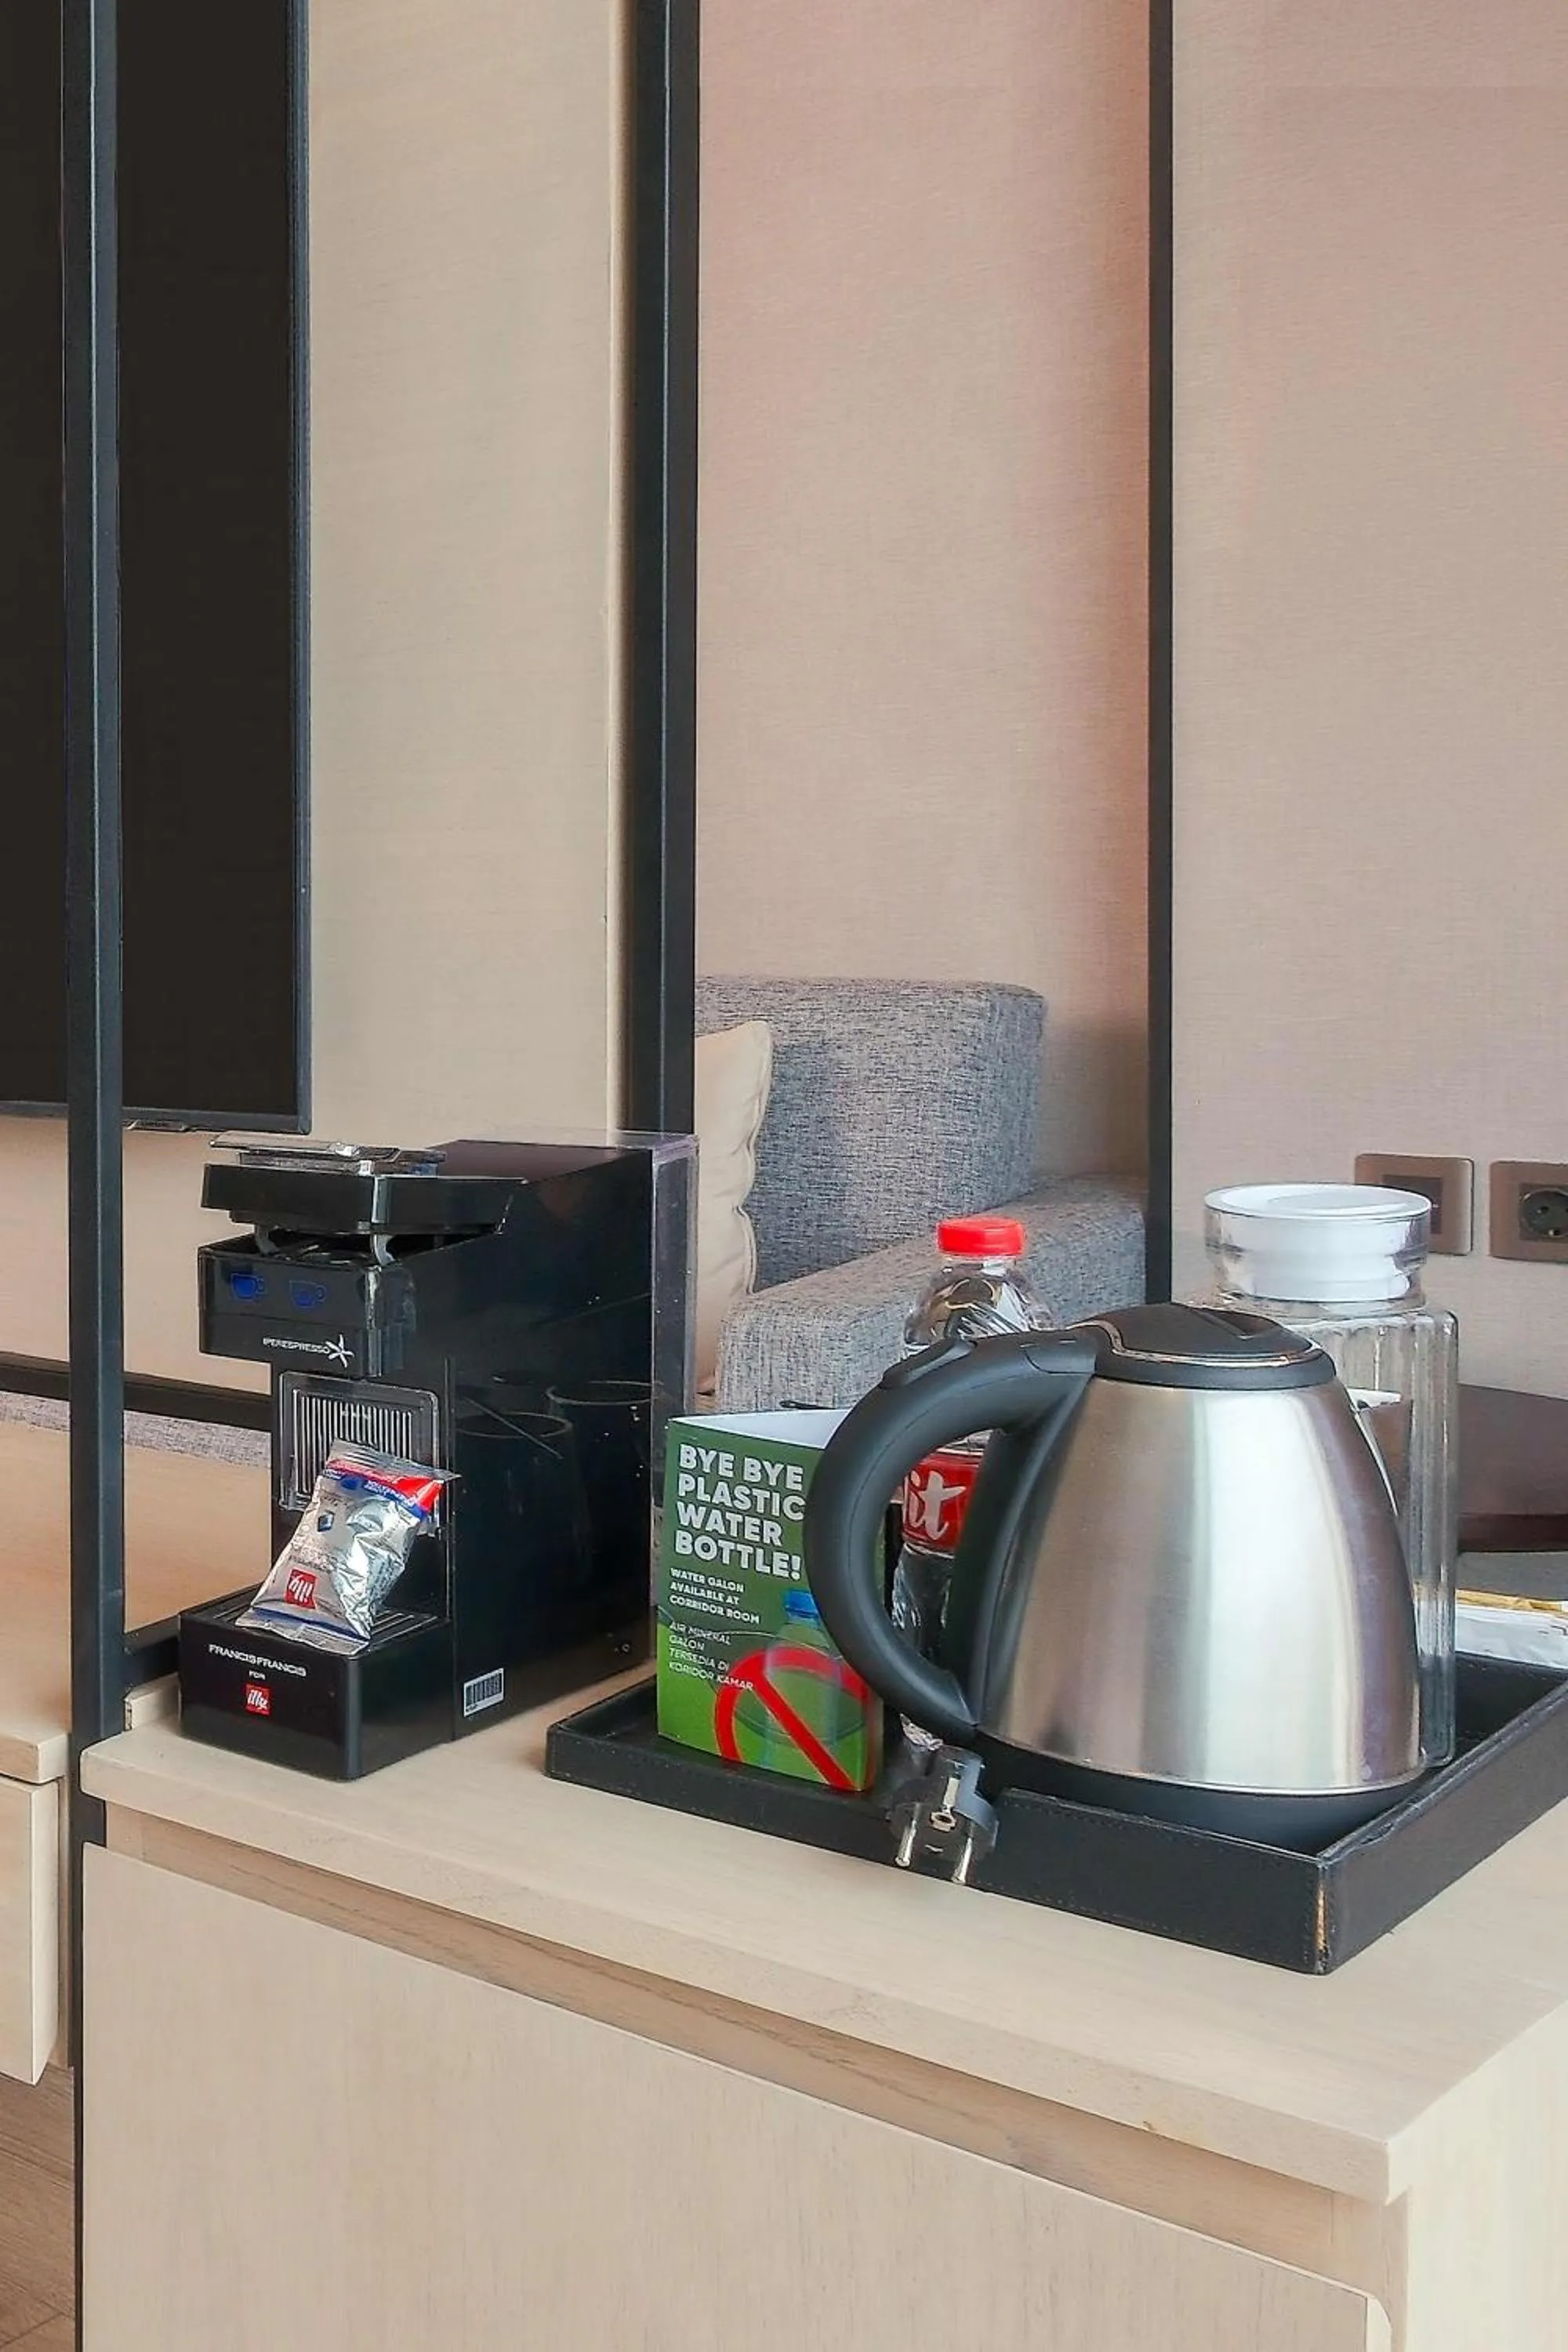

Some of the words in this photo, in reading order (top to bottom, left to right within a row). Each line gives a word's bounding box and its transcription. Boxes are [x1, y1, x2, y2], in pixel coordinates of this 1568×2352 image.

[680, 1443, 735, 1478] BYE
[744, 1457, 804, 1491] BYE
[678, 1473, 807, 1521] PLASTIC
[677, 1501, 782, 1547] WATER
[675, 1530, 801, 1581] BOTTLE!
[288, 1574, 314, 1603] illy
[670, 1568, 706, 1584] WATER
[707, 1577, 744, 1592] GALON
[670, 1581, 725, 1602] AVAILABLE
[726, 1595, 740, 1605] AT
[669, 1595, 725, 1616] CORRIDOR
[726, 1608, 760, 1624] ROOM
[669, 1635, 705, 1650] GALON
[670, 1621, 687, 1632] AIR
[688, 1625, 732, 1646] MINERAL
[669, 1648, 716, 1668] TERSEDIA
[717, 1659, 730, 1671] DI
[249, 1670, 266, 1680] FOR
[669, 1661, 714, 1680] KORIDOR
[717, 1674, 754, 1691] KAMAR
[247, 1689, 267, 1710] illy
